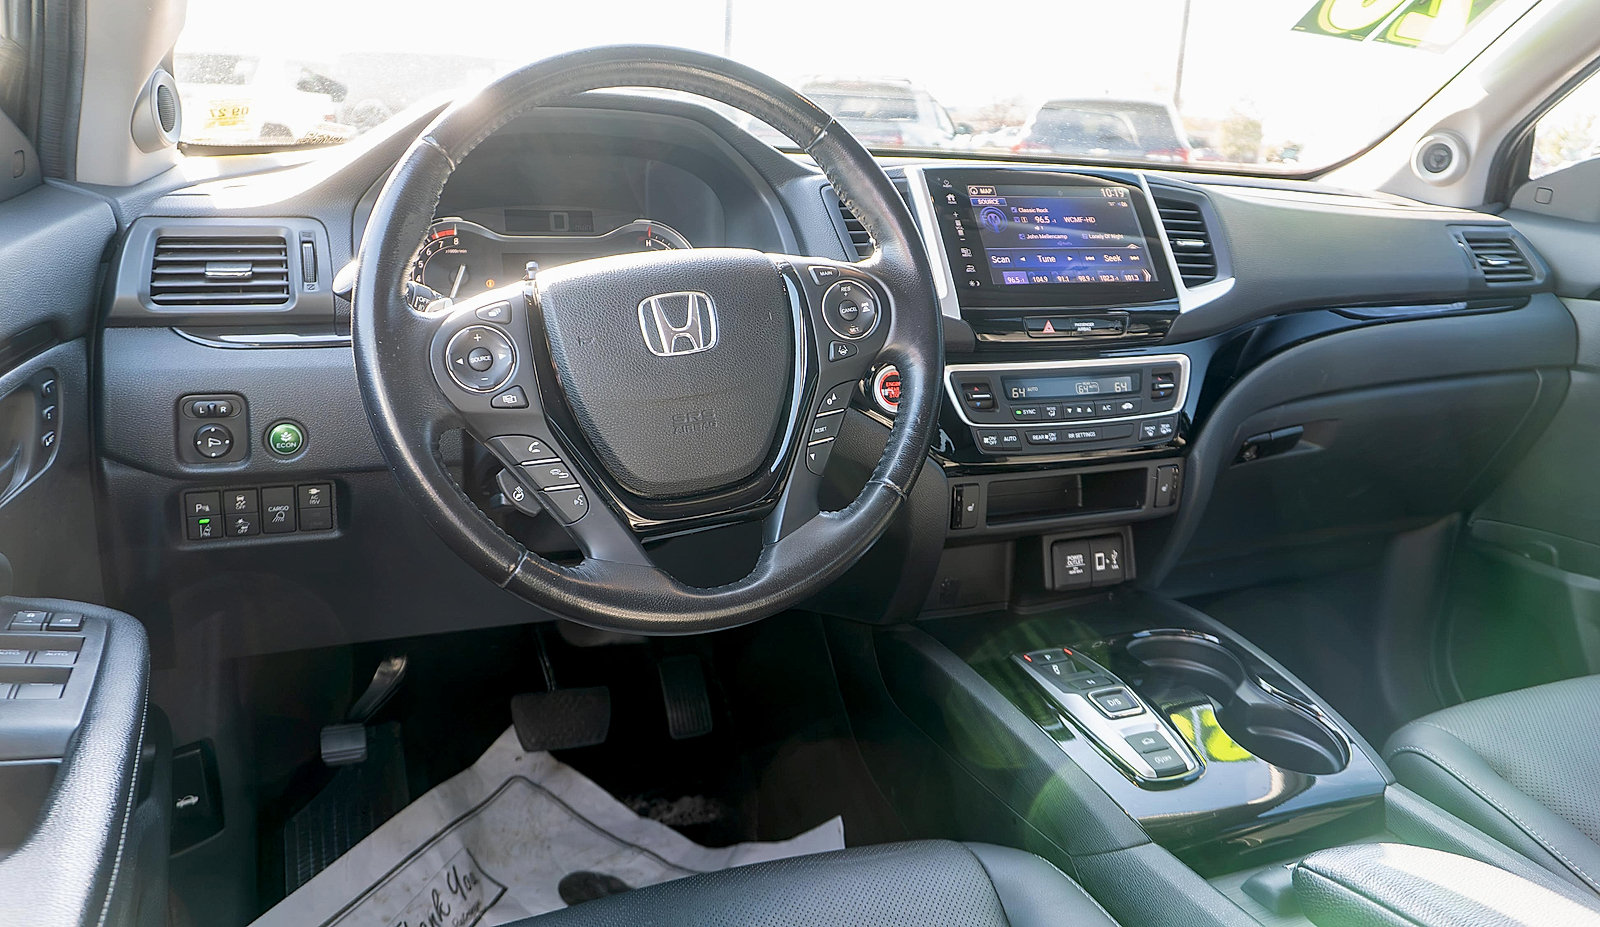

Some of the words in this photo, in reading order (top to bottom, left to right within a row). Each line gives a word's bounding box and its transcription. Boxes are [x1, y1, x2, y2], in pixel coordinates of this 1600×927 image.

[979, 187, 992, 195] MAP
[1101, 188, 1125, 198] 10:19
[1034, 215, 1050, 224] 96.5
[1063, 216, 1096, 224] WCMF-HD
[438, 240, 444, 248] 7
[453, 237, 459, 245] 8
[645, 239, 651, 247] H
[426, 248, 432, 256] 6
[991, 256, 1011, 264] Scan
[1037, 255, 1056, 263] Tune
[1104, 254, 1122, 263] Seek
[418, 260, 424, 268] 5
[415, 274, 421, 282] 4
[470, 355, 492, 364] SOURCE
[1078, 385, 1089, 393] 64
[1114, 382, 1127, 392] 64
[1011, 387, 1026, 398] 64
[1032, 433, 1045, 441] REAR
[1075, 430, 1096, 438] SETTINGS
[447, 865, 479, 900] You
